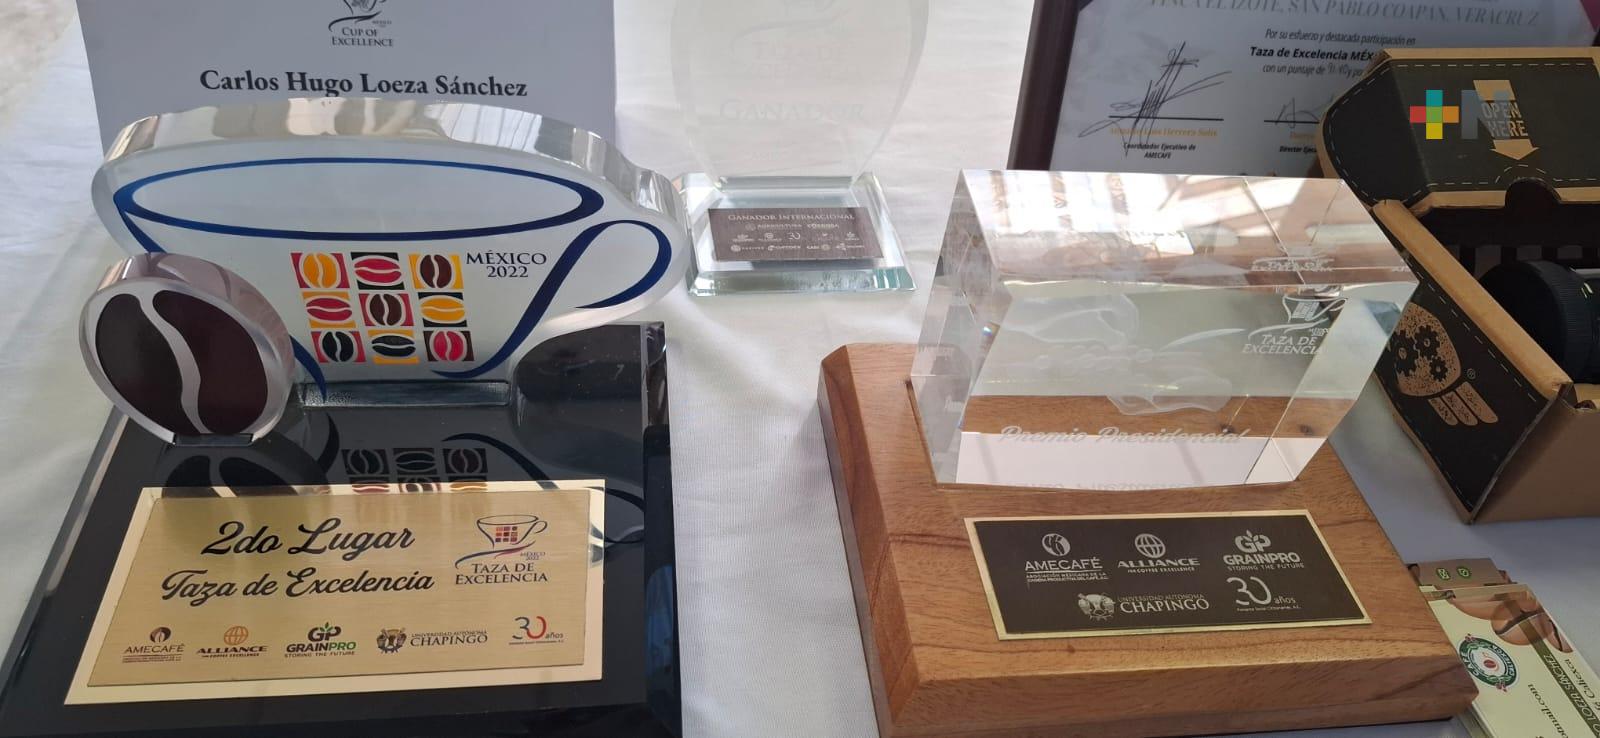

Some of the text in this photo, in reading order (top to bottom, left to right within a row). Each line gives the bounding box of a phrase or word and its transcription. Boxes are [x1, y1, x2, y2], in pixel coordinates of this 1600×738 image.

[1323, 1, 1378, 17] PABLO
[1456, 7, 1540, 26] VERACRUZ
[342, 27, 378, 36] CUP OF
[1264, 29, 1278, 40] Por
[1279, 31, 1288, 40] su
[1288, 30, 1318, 42] esfuerzo
[1325, 32, 1360, 43] destacada
[332, 36, 393, 46] EXCELLENCE
[1250, 46, 1275, 57] Taza
[1276, 46, 1290, 58] de
[1292, 48, 1348, 60] Excelencia
[1276, 65, 1287, 73] un
[200, 70, 528, 98] Carlos Hugo Loeza Sánchez
[719, 98, 867, 121] GANADOR
[1481, 102, 1523, 118] OPEN
[1486, 120, 1529, 137] HERE
[1160, 143, 1188, 151] Ejecutivo
[466, 250, 547, 264] MÉXICO
[486, 266, 529, 278] 2022
[1261, 334, 1318, 346] TAZA DE
[1000, 425, 1250, 444] Premio Presidencial
[200, 518, 416, 562] 2do Lugar
[1024, 556, 1104, 572] AMECAFÉ
[1118, 558, 1200, 568] ALLIANCE
[1223, 552, 1301, 566] GRAINPRO
[471, 562, 535, 574] TAZA DE
[455, 572, 548, 585] EXCELENCIA
[161, 567, 436, 607] Taza de Excelencia
[1226, 576, 1272, 606] 30
[1120, 598, 1210, 614] CHAPINGO
[512, 616, 547, 640] 30
[410, 634, 488, 646] CHAPINGO
[124, 643, 186, 654] AMECAFÉ
[196, 645, 269, 654] ALLIANCE
[286, 642, 357, 653] GRAINPRO
[1564, 658, 1595, 698] Caliexca
[1571, 693, 1597, 720] LOEZA
